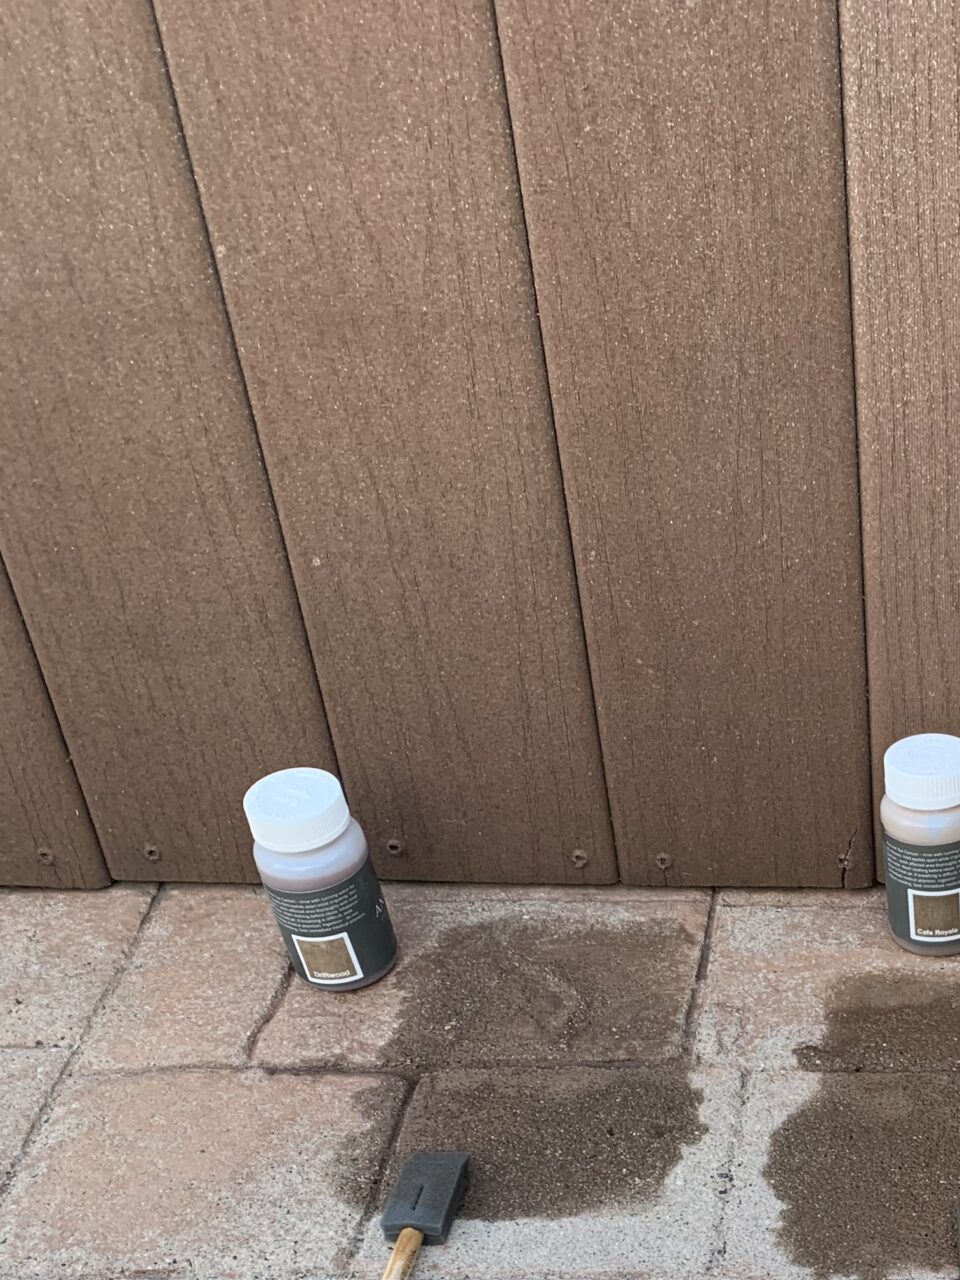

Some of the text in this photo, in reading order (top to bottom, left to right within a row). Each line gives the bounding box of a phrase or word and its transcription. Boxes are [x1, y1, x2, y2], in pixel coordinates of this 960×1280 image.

[917, 928, 959, 936] Cafe Royale
[313, 969, 350, 978] Driftwood
